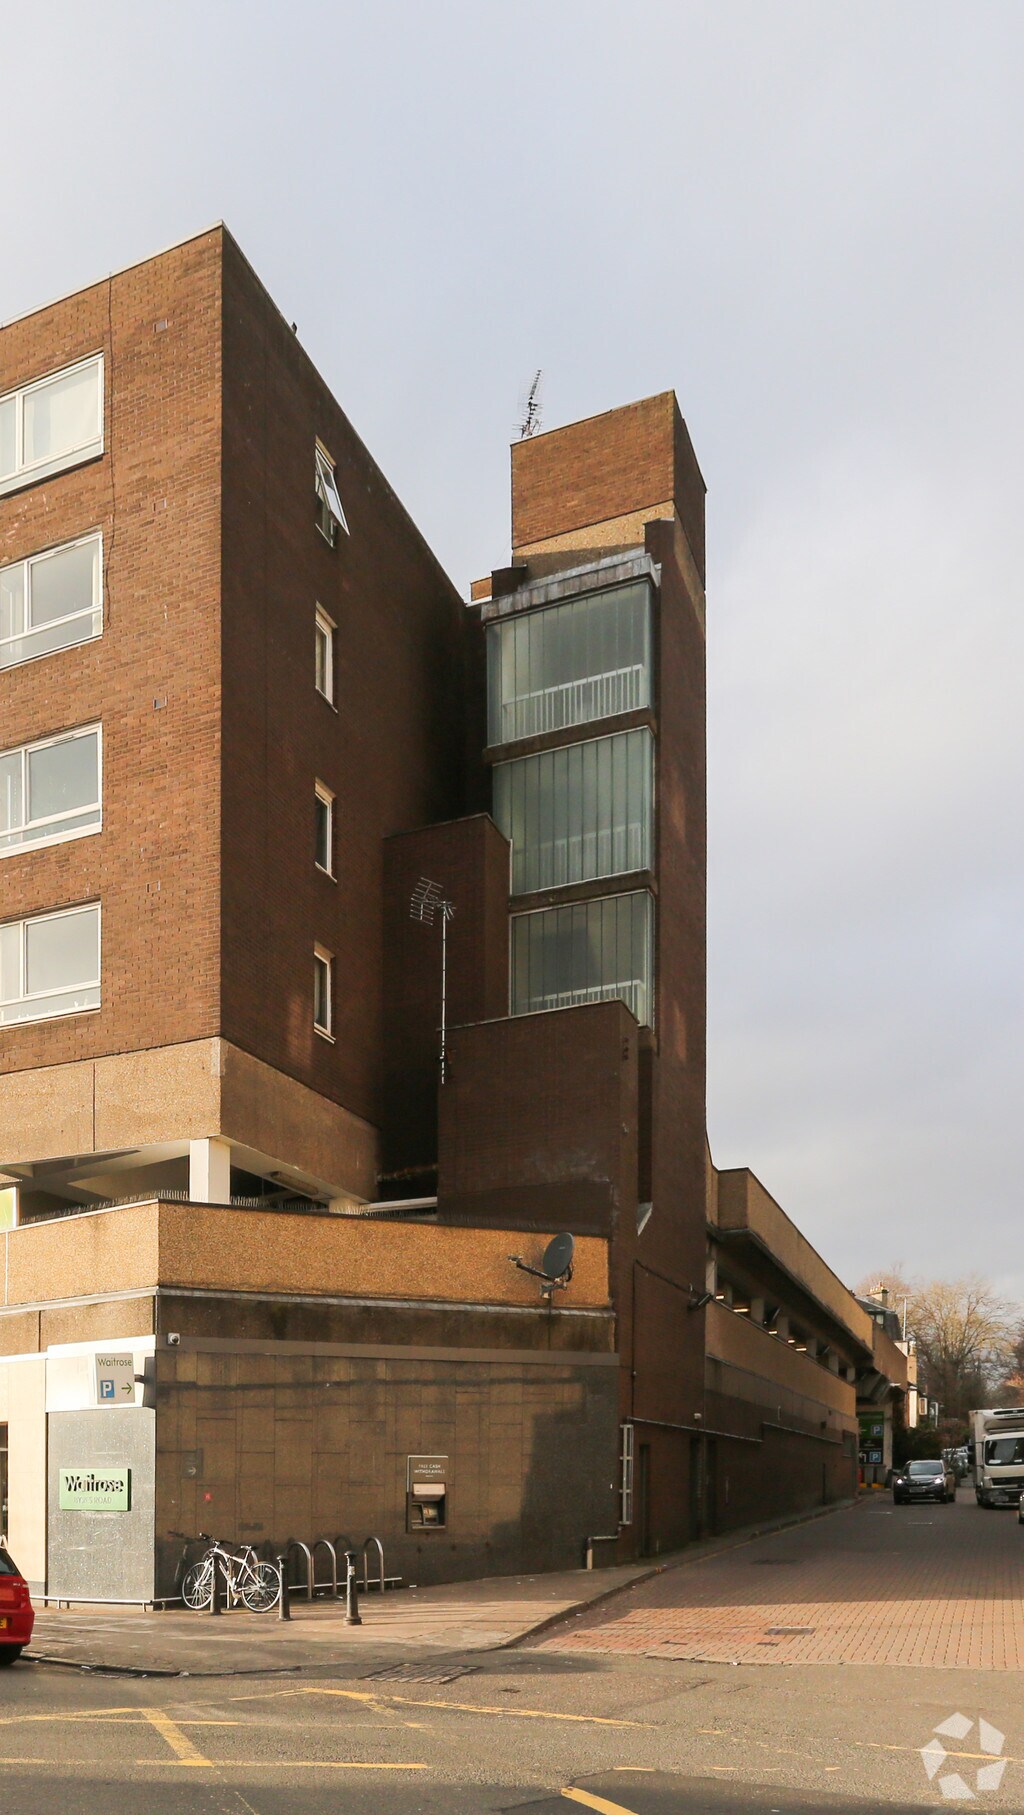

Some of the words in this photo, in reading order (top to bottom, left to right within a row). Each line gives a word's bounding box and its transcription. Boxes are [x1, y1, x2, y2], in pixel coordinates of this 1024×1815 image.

[97, 1357, 133, 1367] Waitrose
[102, 1381, 112, 1397] P
[65, 1474, 124, 1492] Waitrose
